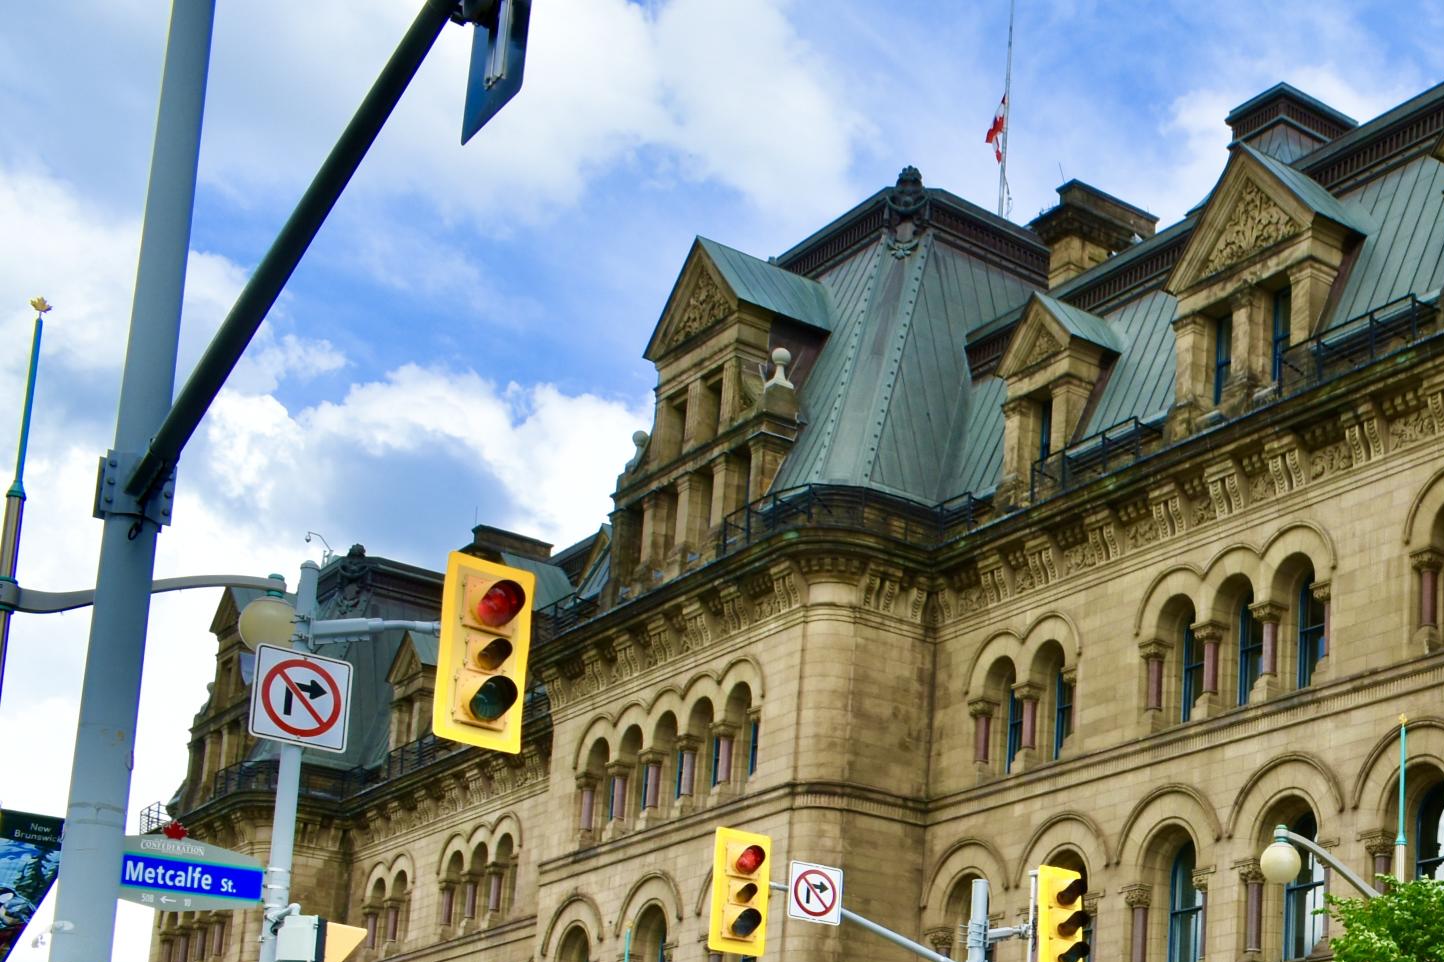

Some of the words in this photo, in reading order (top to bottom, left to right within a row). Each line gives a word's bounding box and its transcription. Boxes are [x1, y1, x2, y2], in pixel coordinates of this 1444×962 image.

[30, 822, 51, 833] New
[14, 829, 64, 844] Brunswick
[125, 860, 213, 891] Metcalfe
[220, 878, 237, 893] St.
